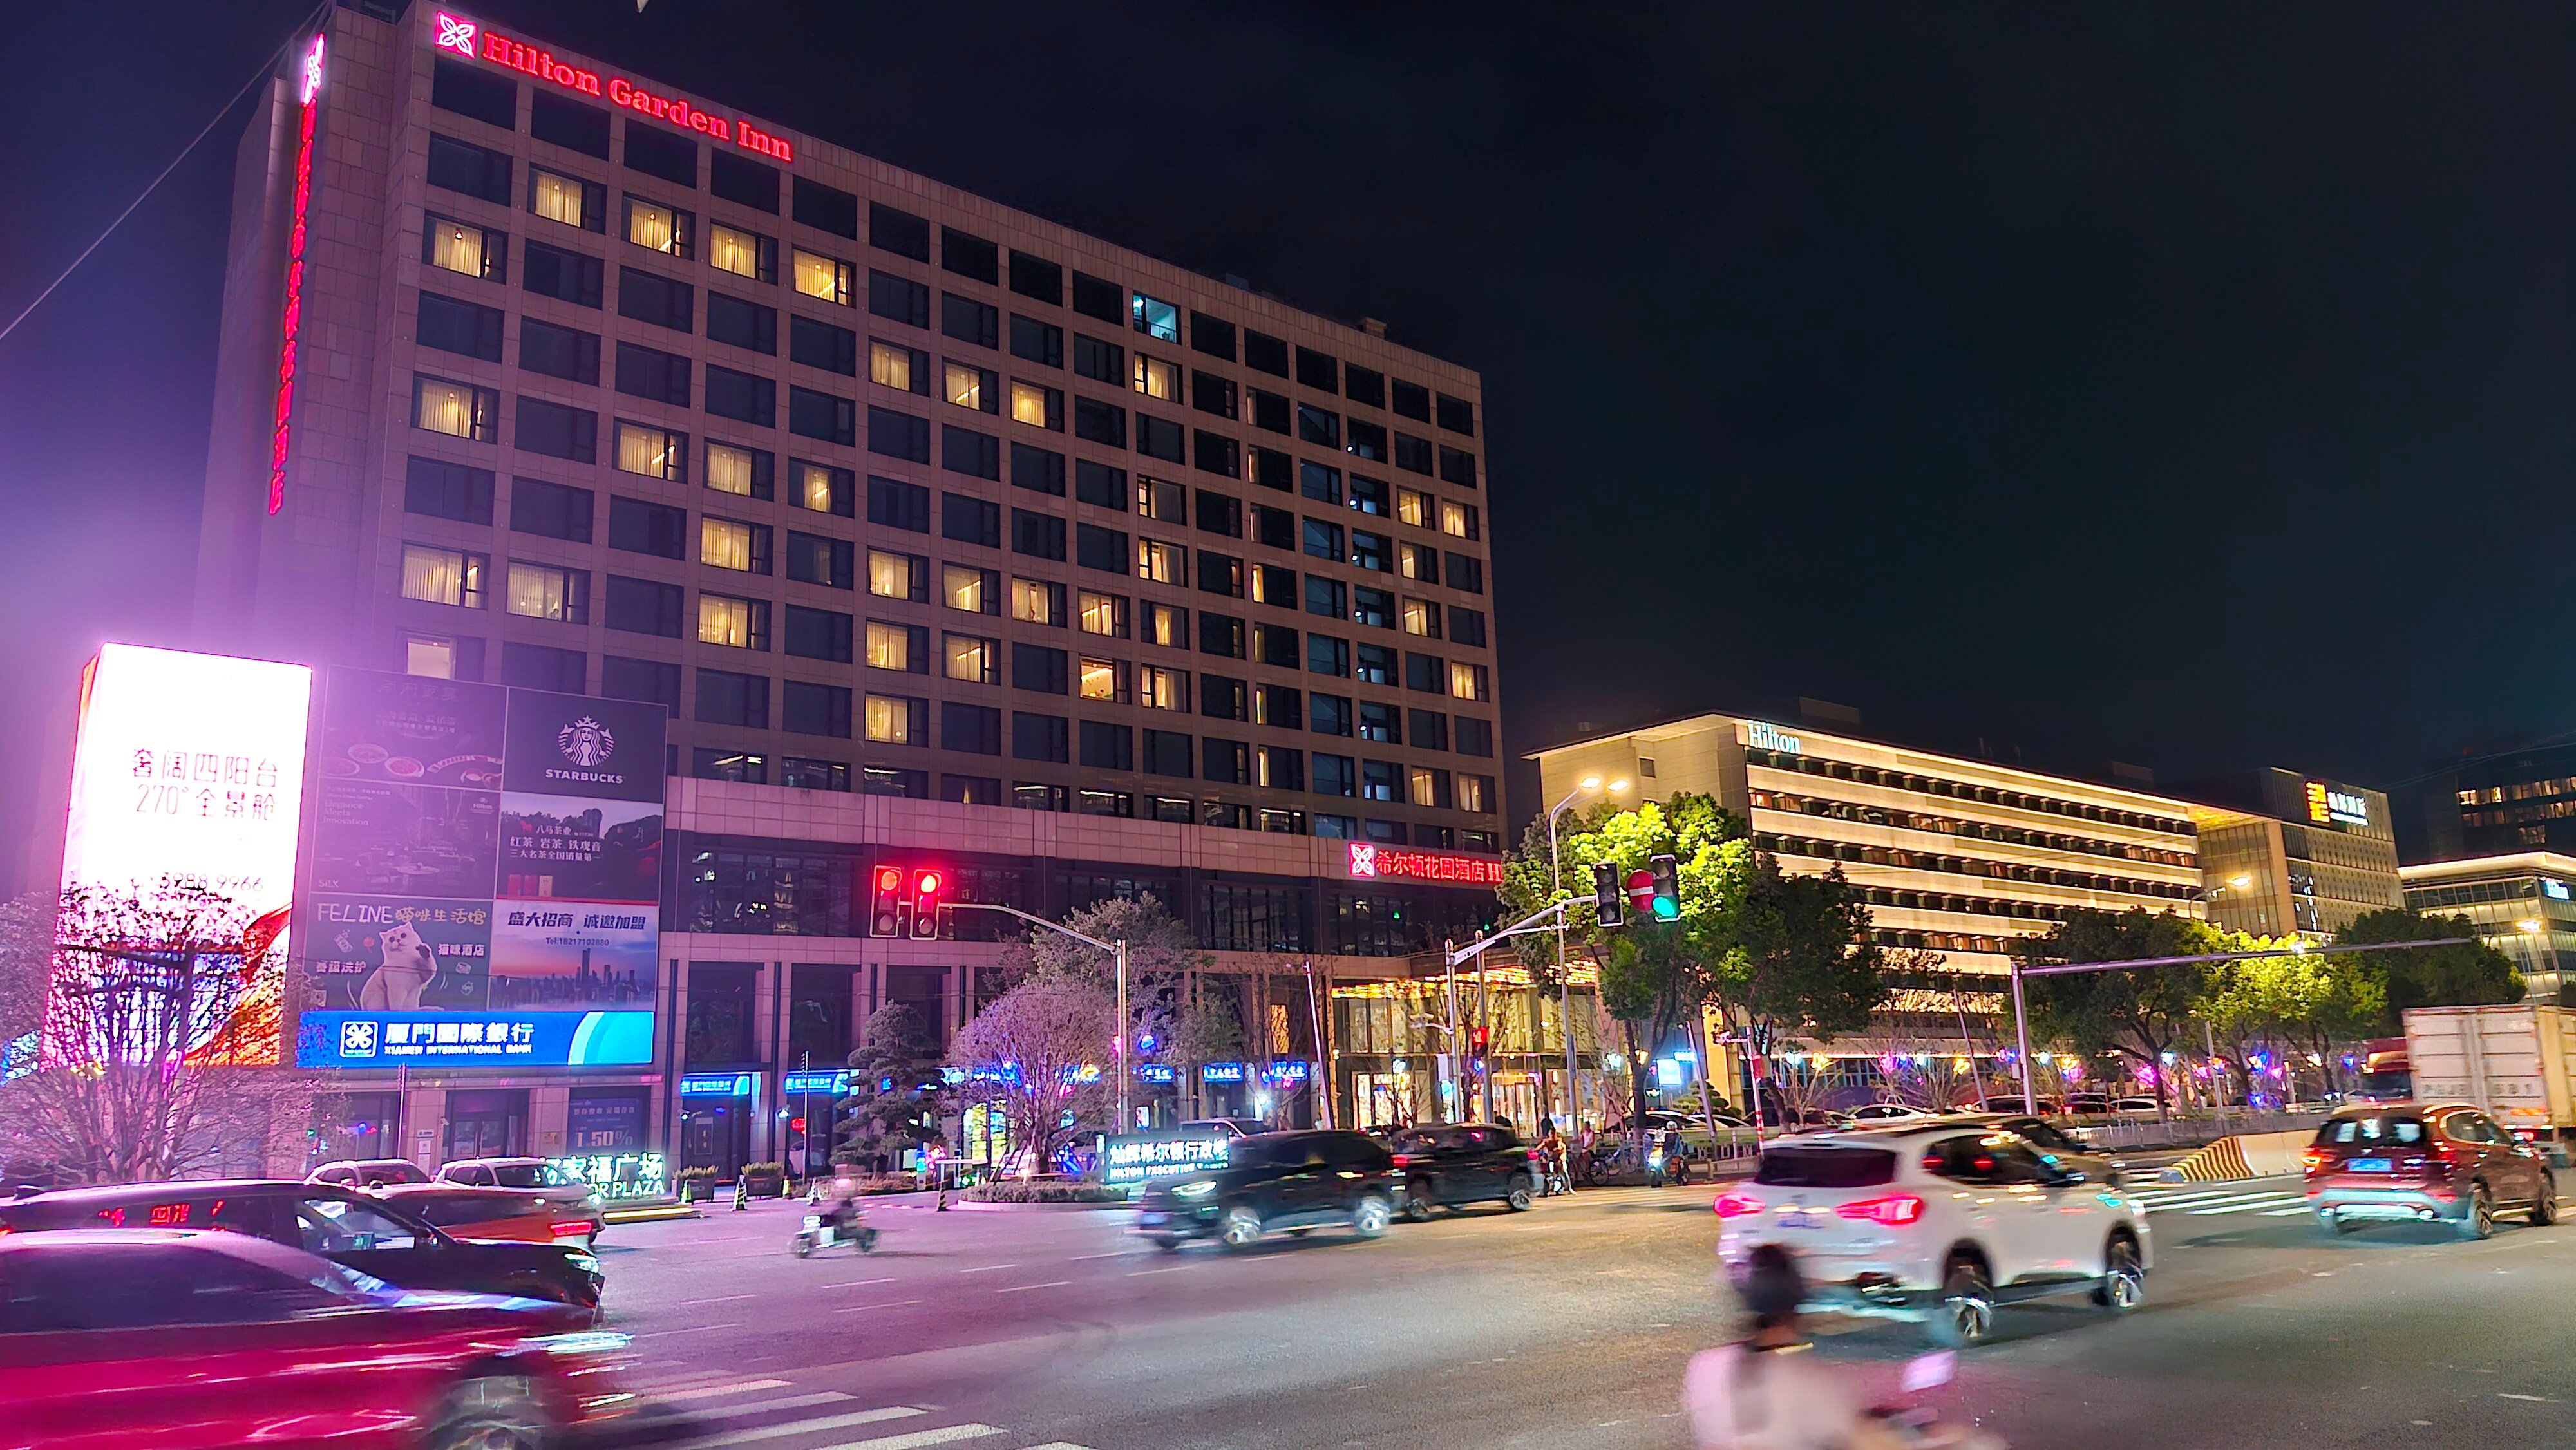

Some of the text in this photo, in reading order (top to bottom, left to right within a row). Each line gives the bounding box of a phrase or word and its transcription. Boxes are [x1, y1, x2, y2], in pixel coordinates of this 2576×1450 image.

[483, 32, 792, 162] Hilton Garden Inn
[1747, 720, 1801, 755] Hilton
[132, 748, 278, 787] 奢阔四阳台
[545, 769, 624, 784] STARBUCKS
[136, 784, 276, 821] 270°全景舱
[324, 799, 364, 810] Elegance
[323, 808, 351, 816] Meets
[323, 815, 369, 826] Innovation
[536, 824, 572, 836] 八马茶业
[509, 836, 602, 853] 红茶 岩茶 铁观音
[509, 848, 601, 862] 三大名茶全国销量第一
[1376, 851, 1485, 883] 希尔顿花园酒店
[216, 874, 263, 892] 9966
[317, 903, 488, 925] FELINE 猫咪生活馆
[507, 911, 647, 930] 盛大招商 诚邀加盟
[438, 943, 486, 957] 猫咪酒店
[384, 1044, 533, 1055] XIAMEN INTERNATIONAL BANK
[576, 1130, 634, 1148] 1.50%
[1109, 1166, 1144, 1180] HILTON
[611, 1179, 666, 1198] PLAZA
